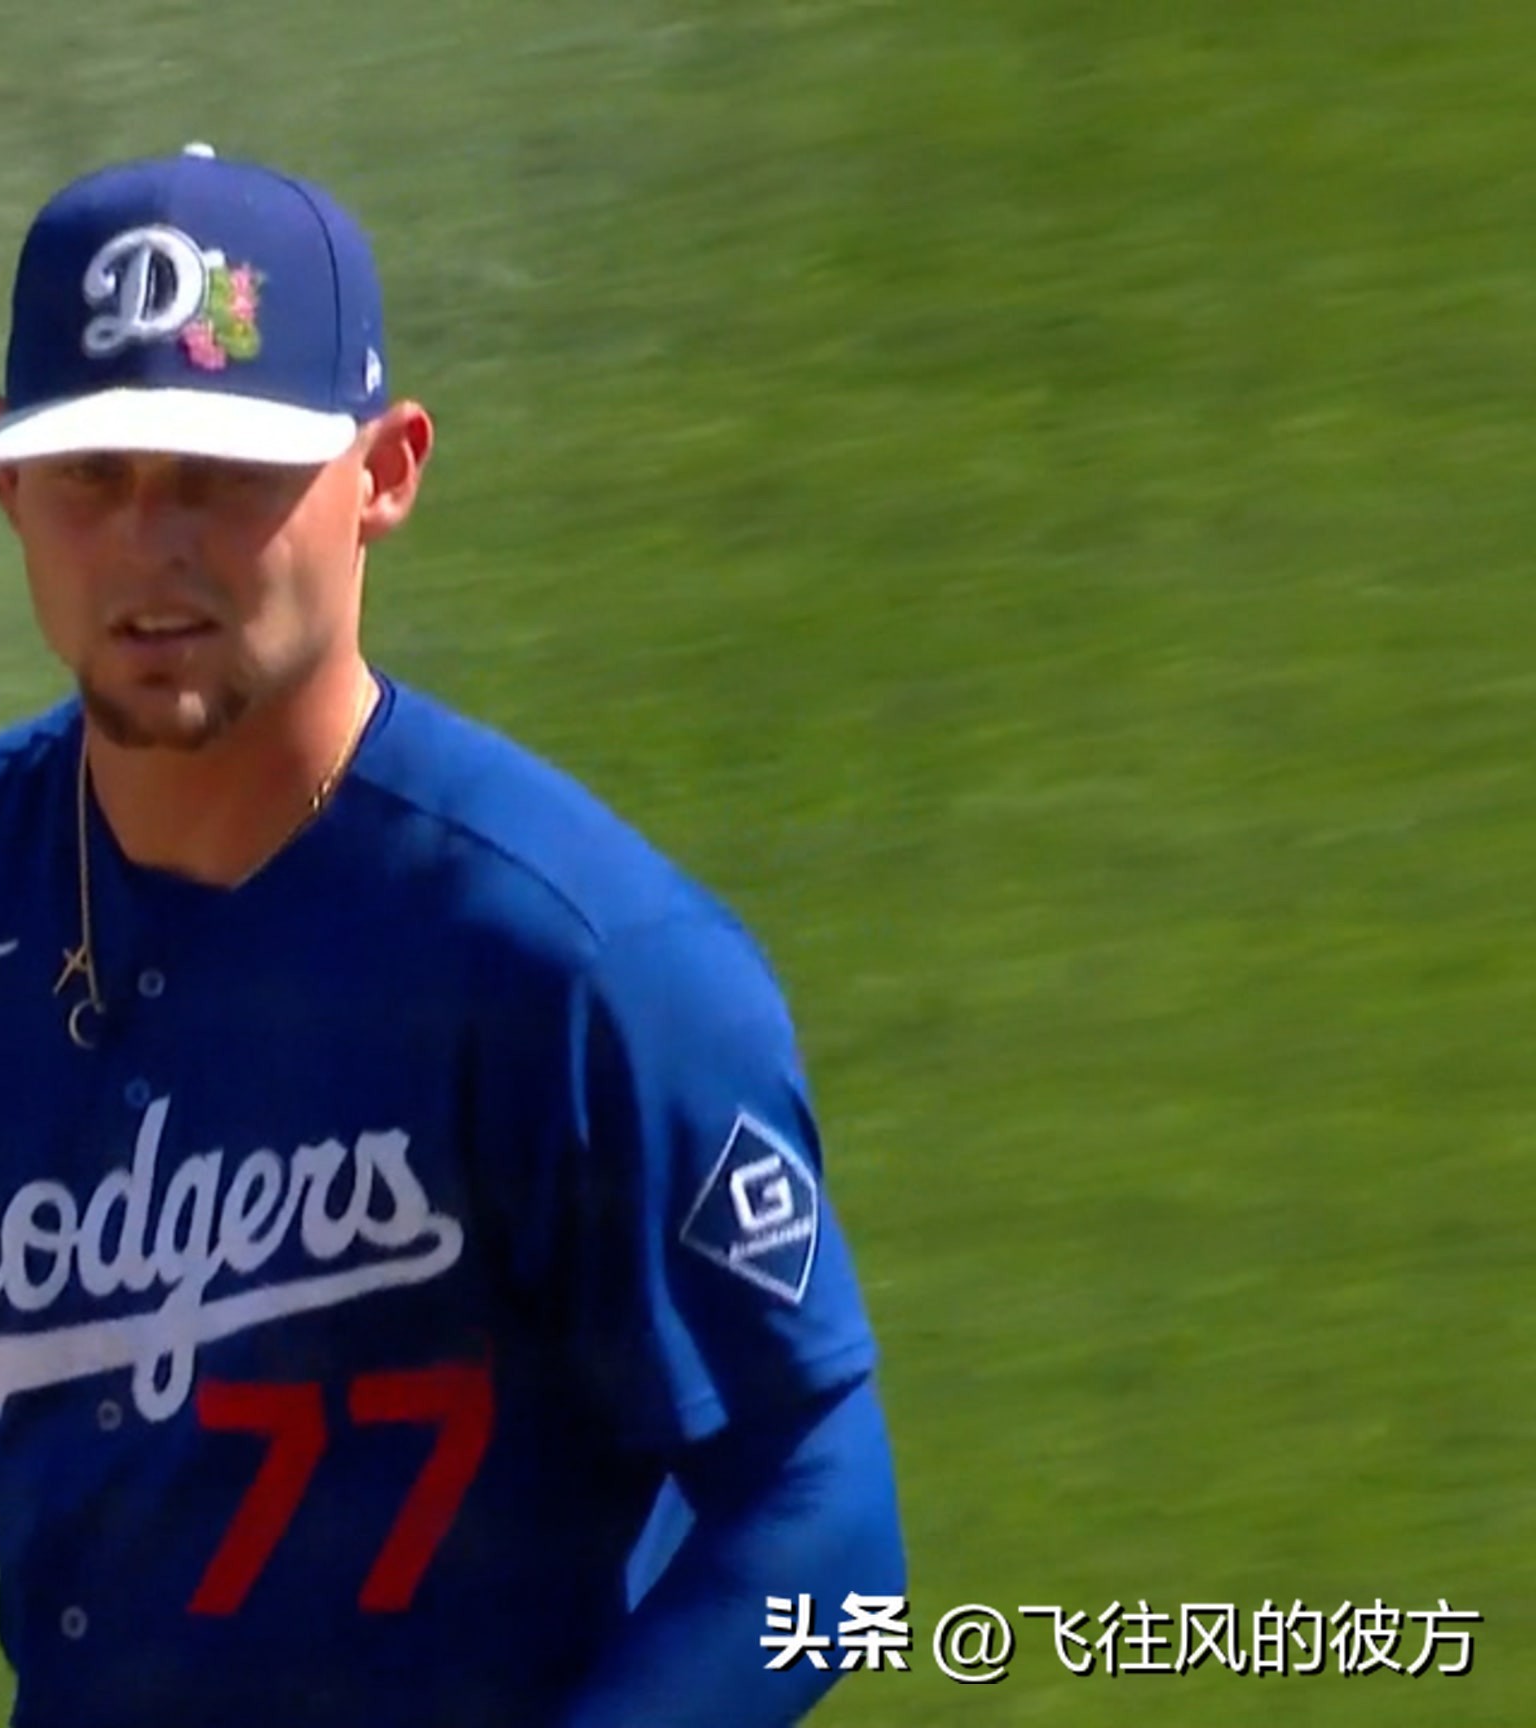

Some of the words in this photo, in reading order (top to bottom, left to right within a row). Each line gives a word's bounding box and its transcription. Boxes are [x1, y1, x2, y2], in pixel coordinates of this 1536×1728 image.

[82, 224, 207, 360] D
[730, 1153, 794, 1232] G
[186, 1364, 495, 1616] 77
